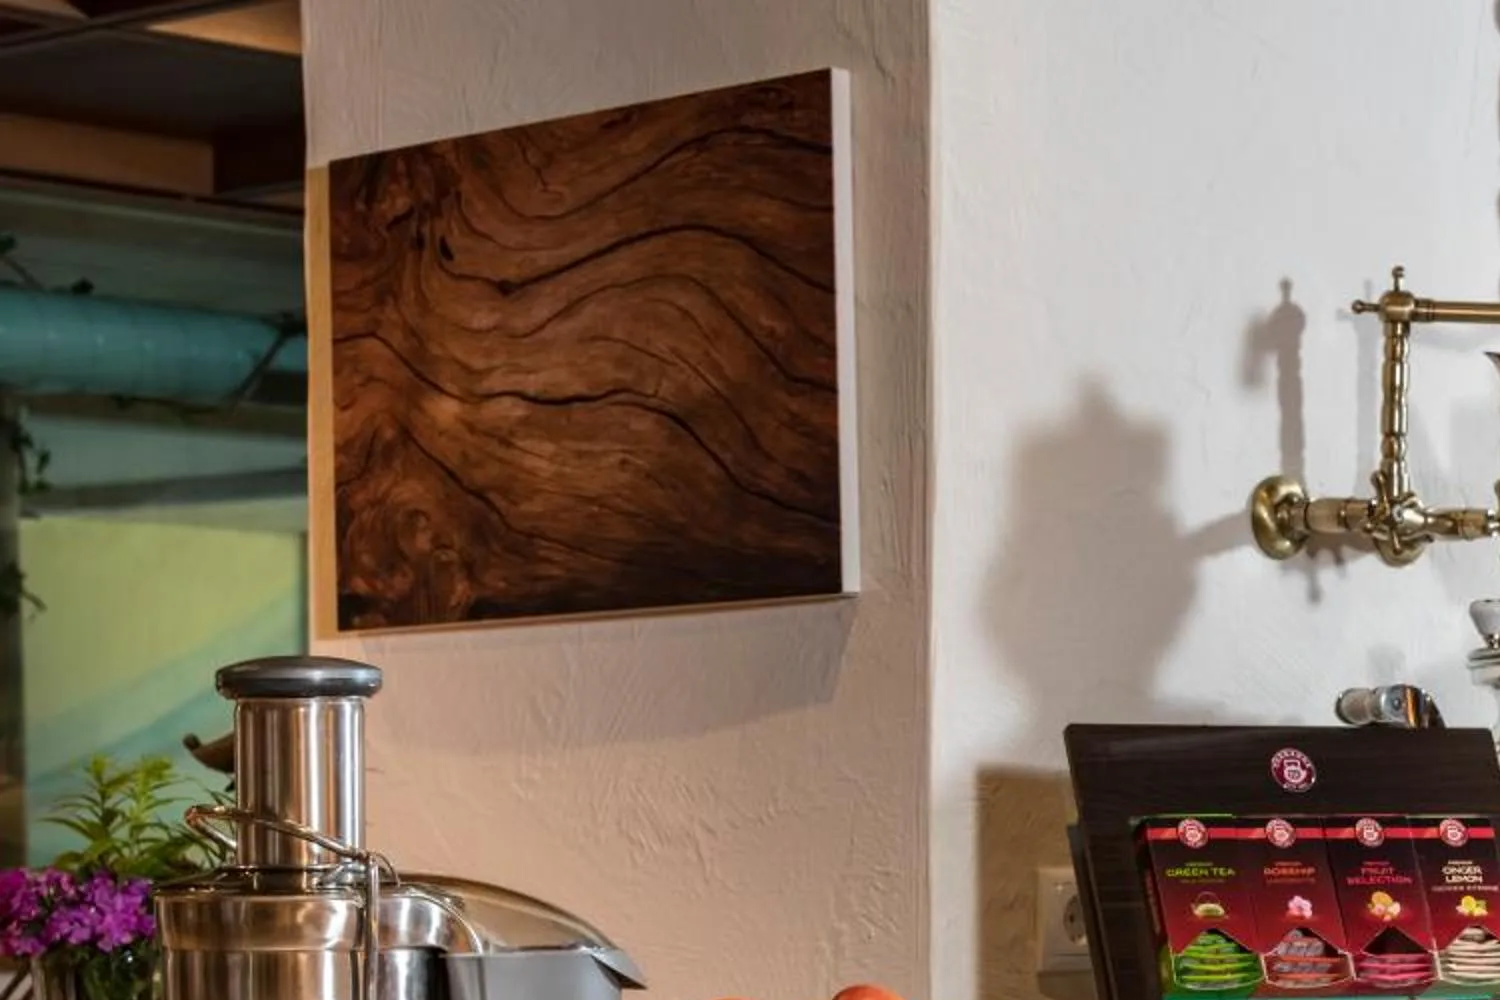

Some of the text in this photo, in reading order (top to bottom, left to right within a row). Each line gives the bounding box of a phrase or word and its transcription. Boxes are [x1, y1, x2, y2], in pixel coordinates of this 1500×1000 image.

[1165, 866, 1236, 877] GREEN TEA
[1445, 875, 1483, 883] LEMON
